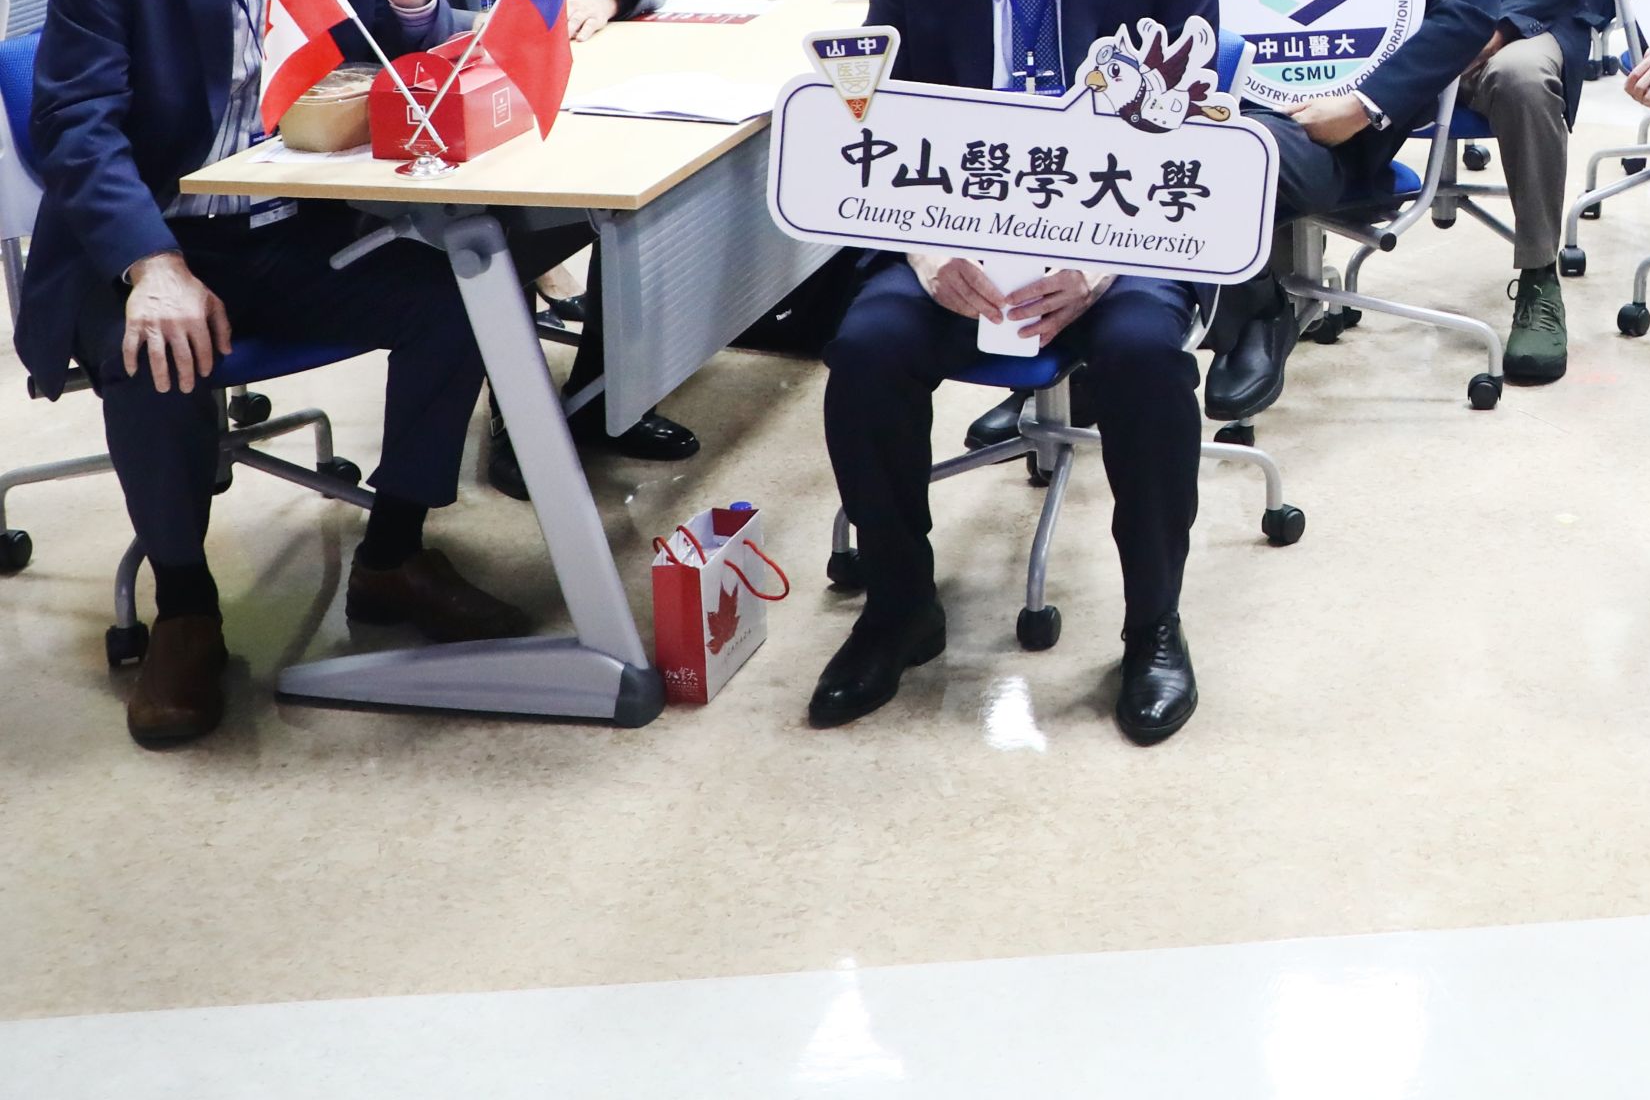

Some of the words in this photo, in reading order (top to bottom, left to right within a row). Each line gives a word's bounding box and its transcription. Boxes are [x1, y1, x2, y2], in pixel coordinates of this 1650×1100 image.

[1257, 33, 1357, 60] 中山醫大
[1281, 65, 1337, 82] CSMU
[840, 127, 1212, 224] 中山醫學大學
[837, 196, 917, 231] Chung
[921, 205, 981, 233] Shan
[987, 212, 1081, 244] Medical
[1090, 222, 1206, 260] University
